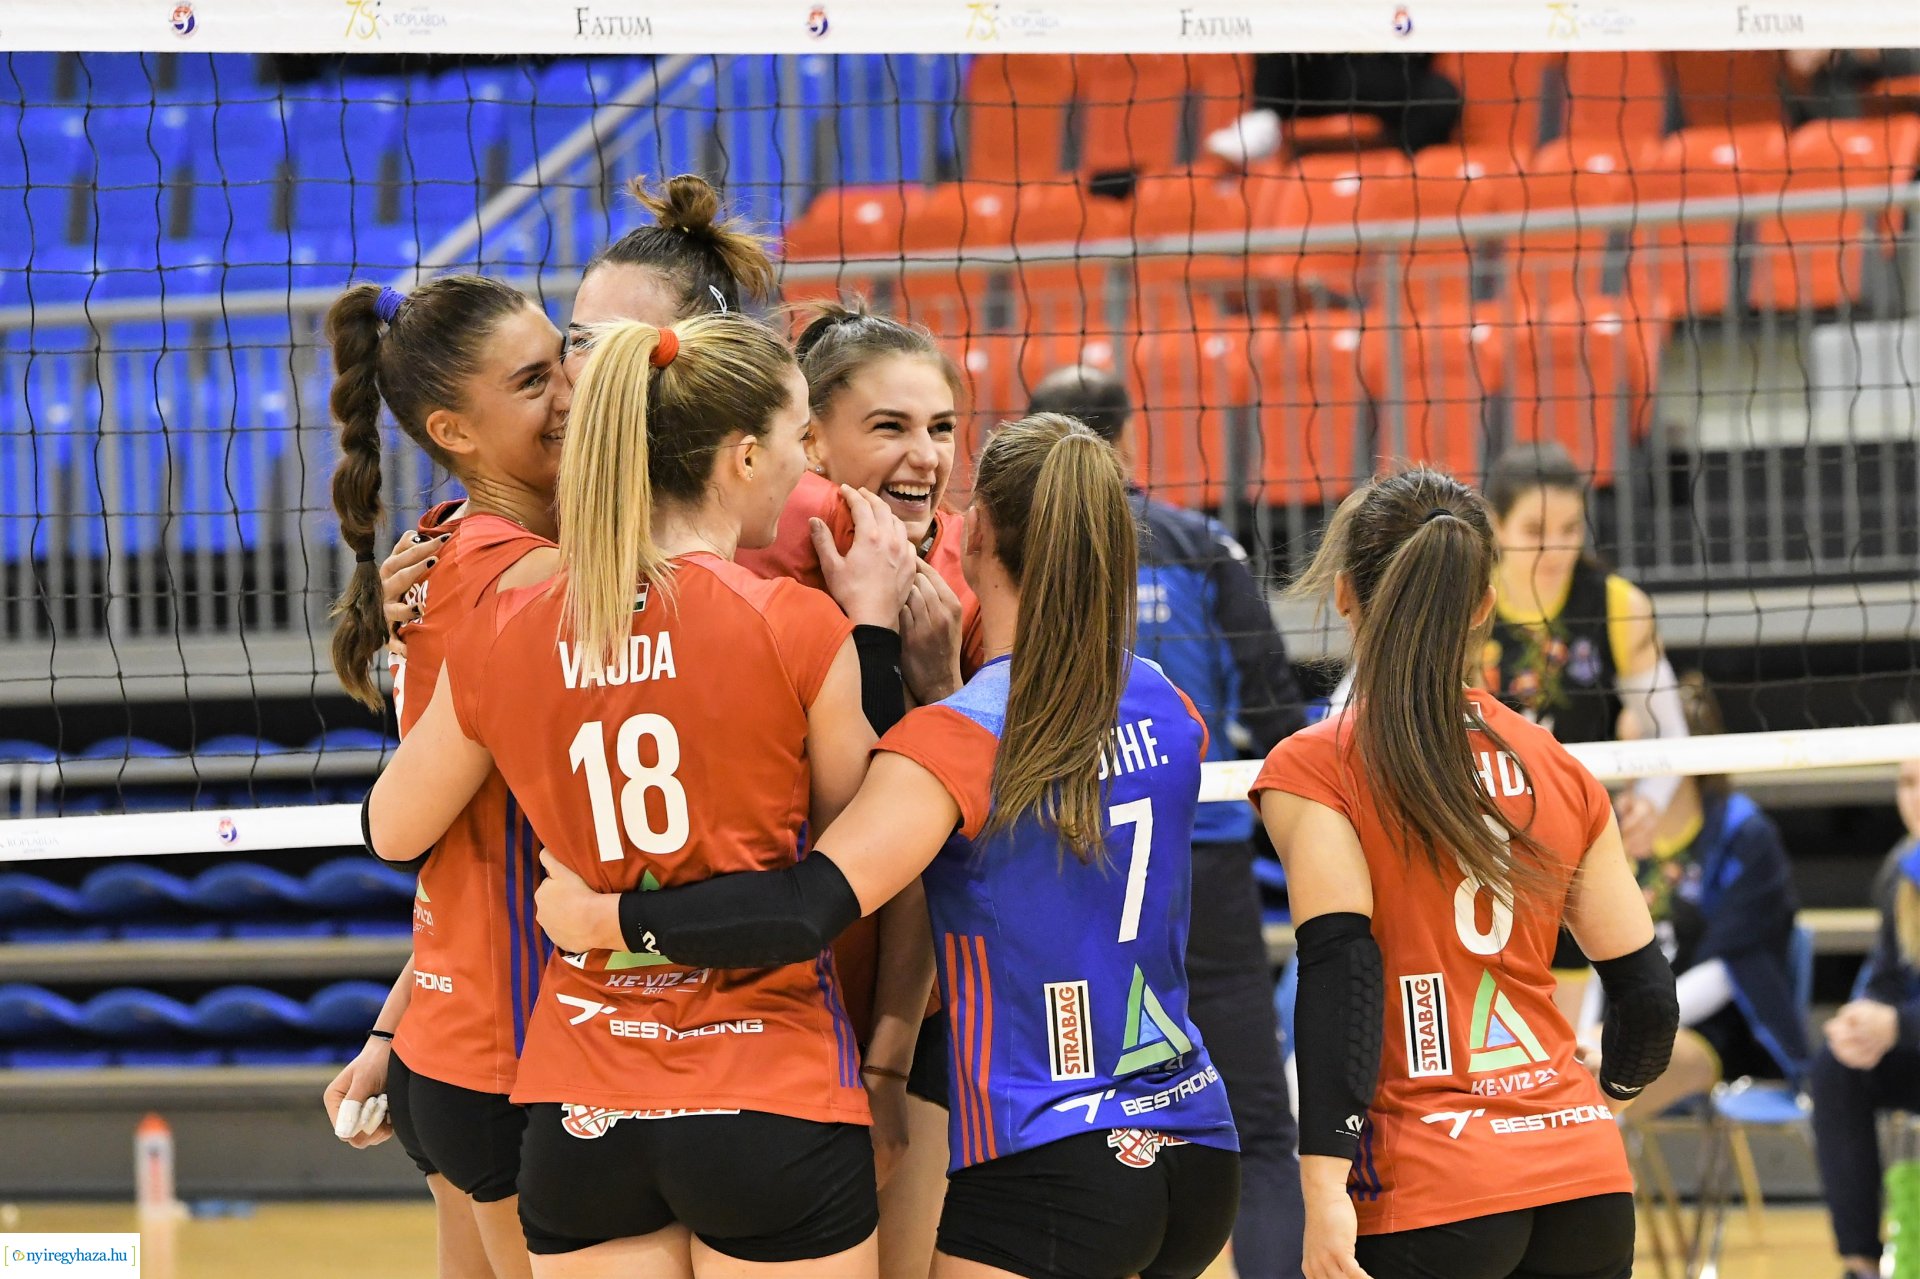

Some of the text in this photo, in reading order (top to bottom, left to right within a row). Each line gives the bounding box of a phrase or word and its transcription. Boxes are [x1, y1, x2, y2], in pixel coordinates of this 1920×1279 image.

[558, 631, 677, 689] VAJDA
[568, 713, 690, 863] 18
[1108, 797, 1153, 943] 7
[609, 1018, 764, 1042] BESTRONG
[1058, 986, 1081, 1075] STRABAG
[1414, 978, 1439, 1072] STRABAG
[1120, 1065, 1219, 1117] BESTRONG
[1489, 1104, 1614, 1135] BESTRONG
